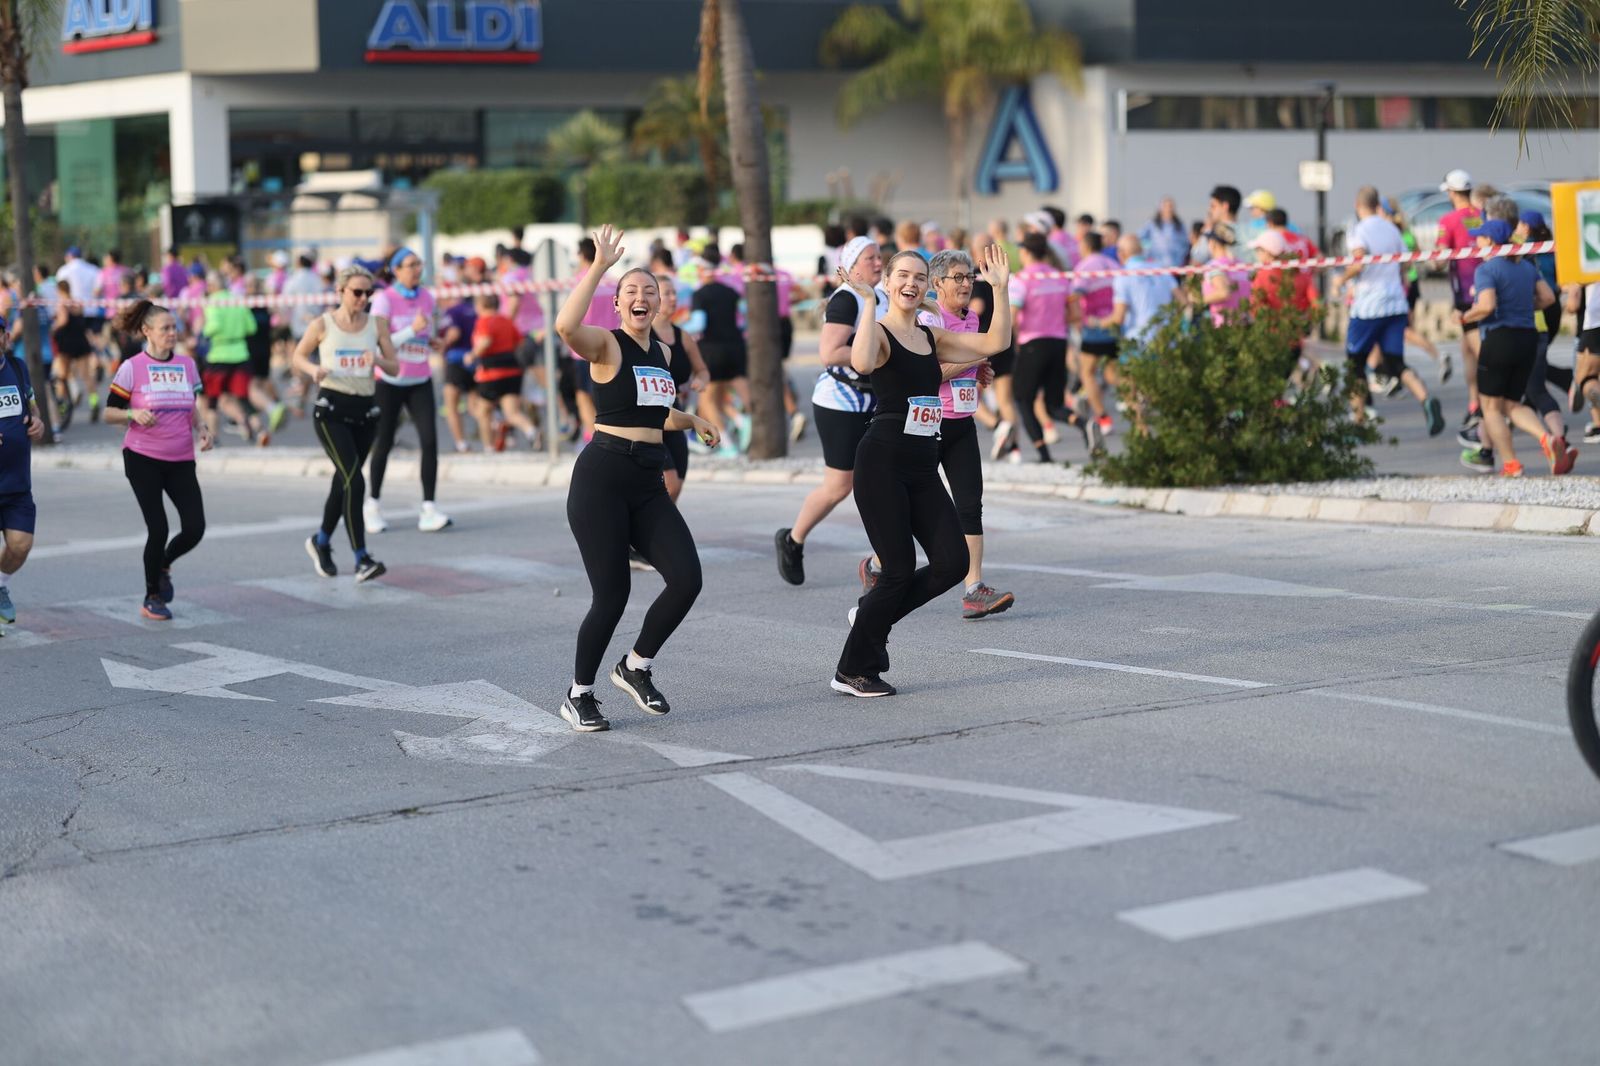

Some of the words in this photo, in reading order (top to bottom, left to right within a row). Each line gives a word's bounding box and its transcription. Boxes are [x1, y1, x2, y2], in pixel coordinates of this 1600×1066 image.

[62, 0, 153, 40] ALDI
[367, 0, 543, 50] ALDI
[975, 86, 1059, 194] A
[151, 372, 184, 383] 2157
[640, 377, 675, 396] 1135
[959, 388, 975, 401] 682
[912, 406, 942, 423] 1643
